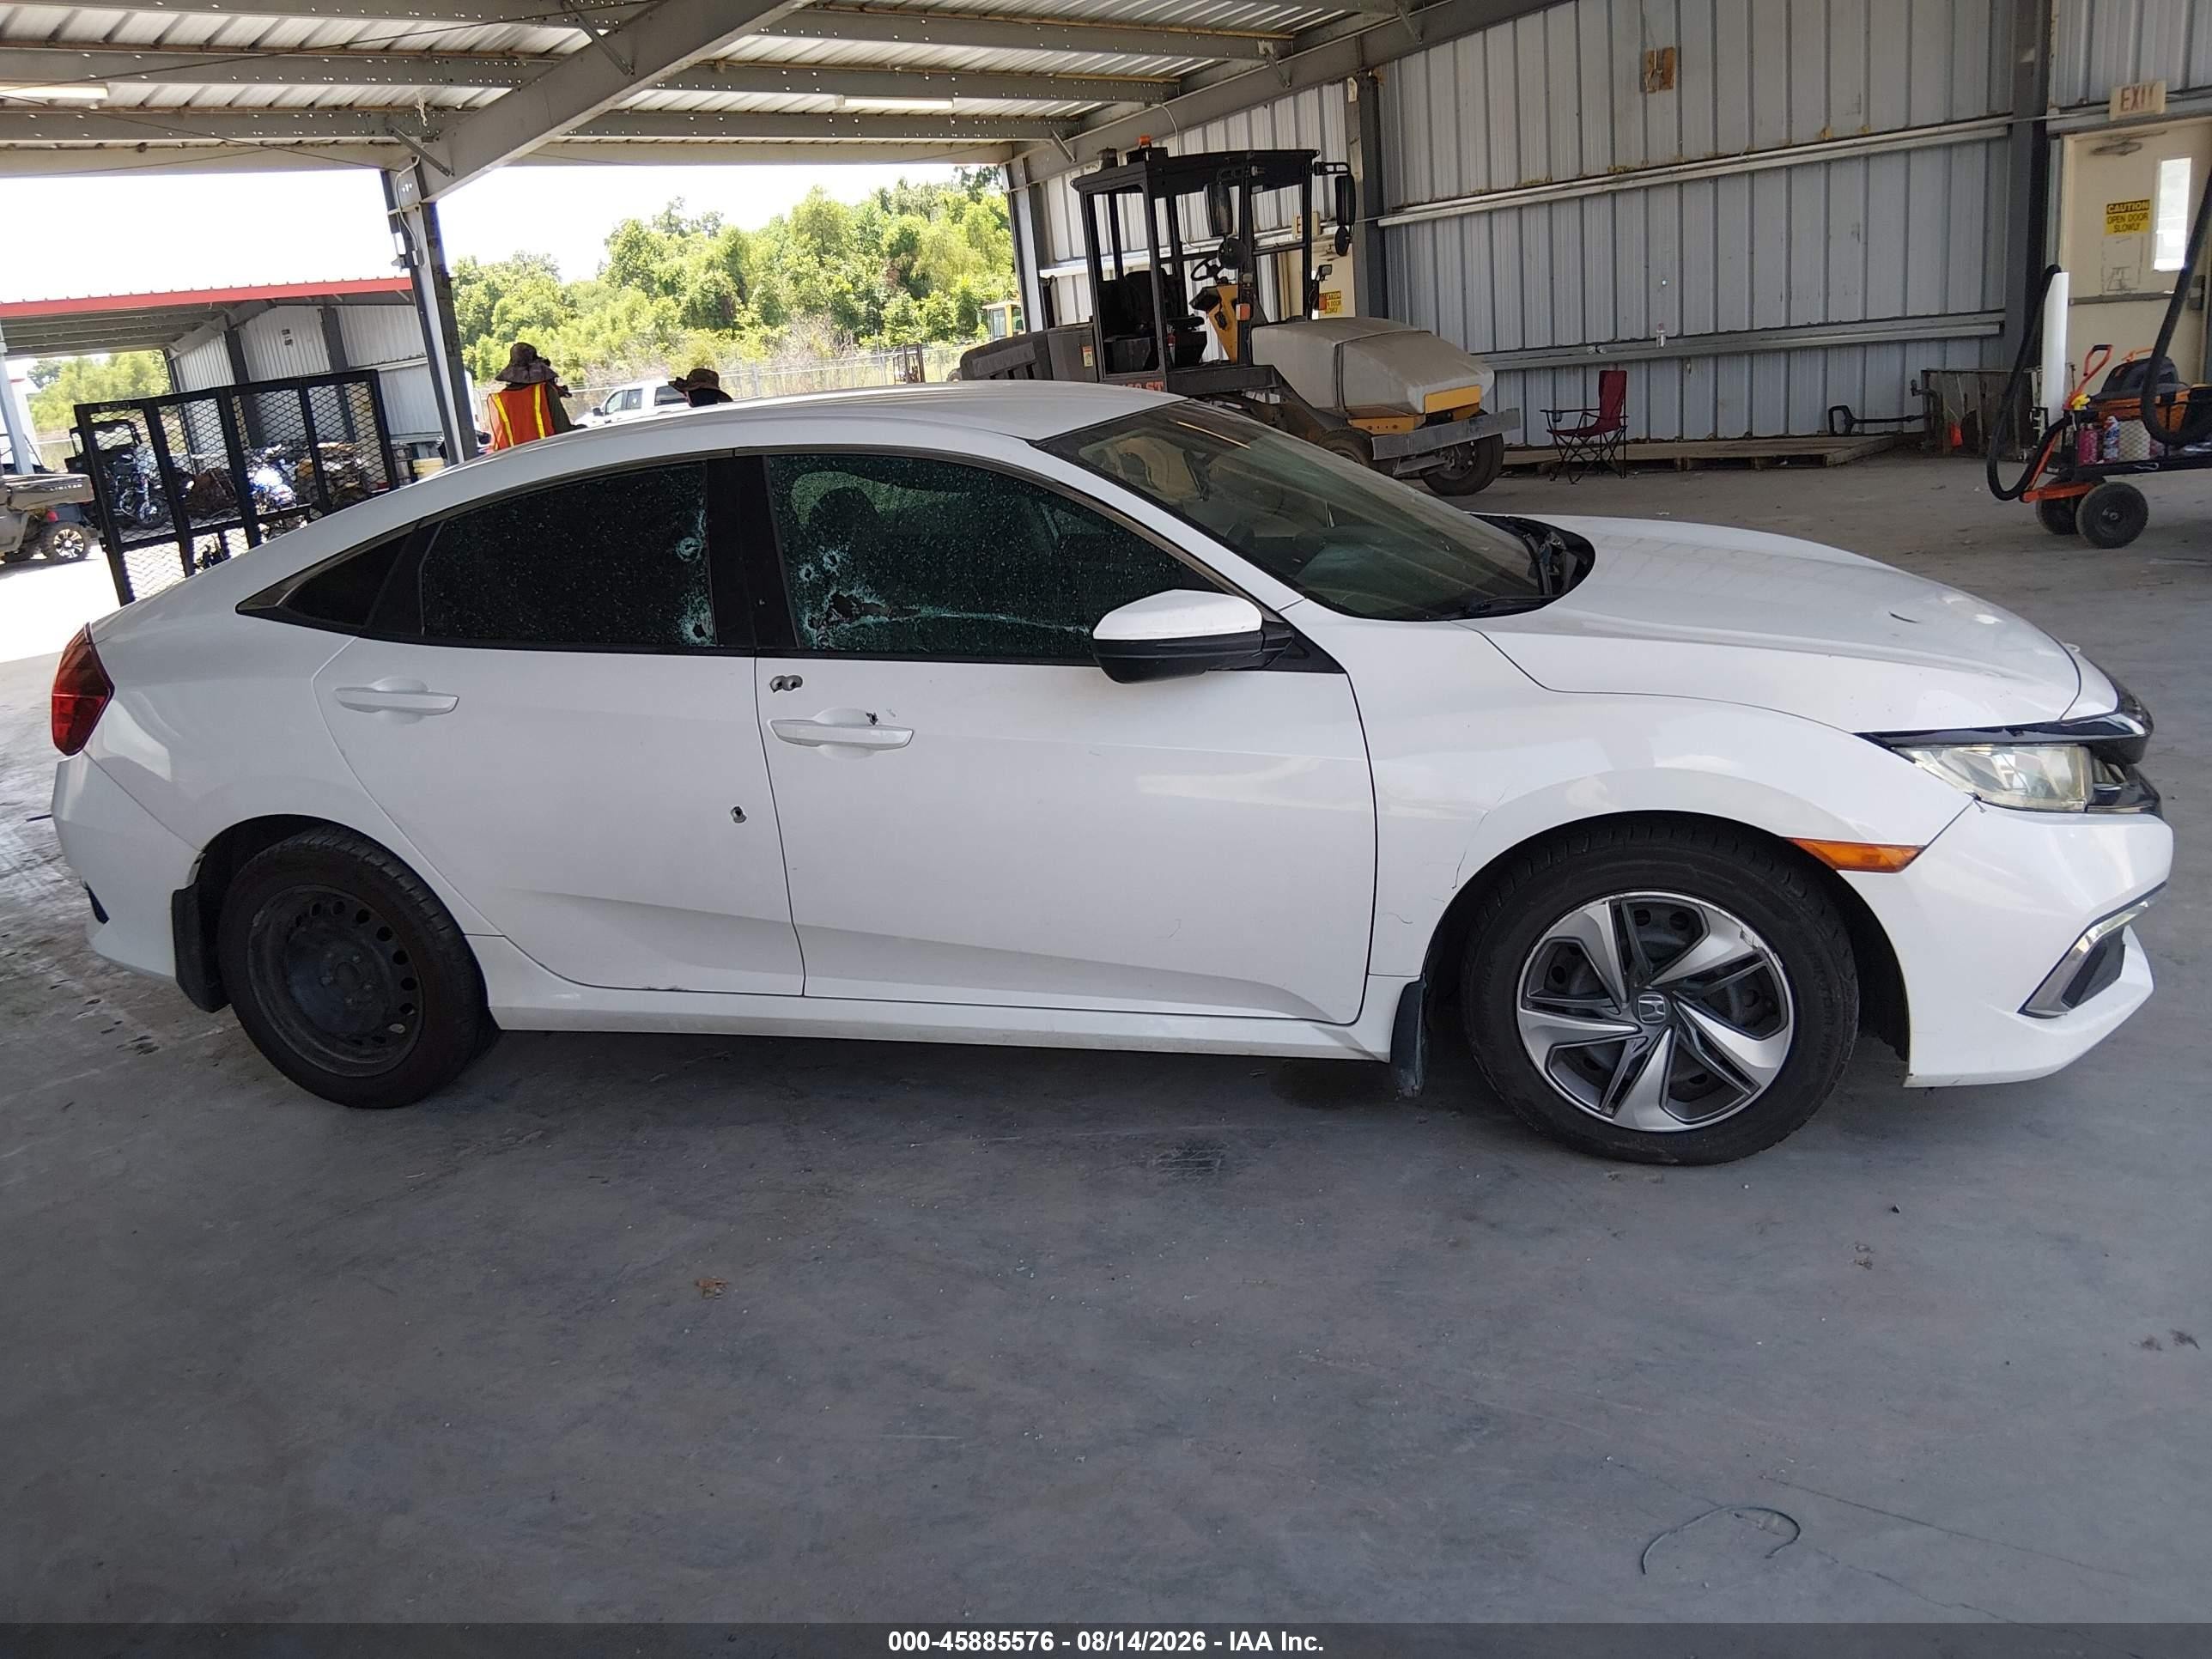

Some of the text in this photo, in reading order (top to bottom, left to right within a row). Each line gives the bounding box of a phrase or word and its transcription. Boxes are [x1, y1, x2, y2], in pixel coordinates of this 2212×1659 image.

[2121, 84, 2156, 111] EXIT
[2108, 201, 2148, 213] CAUTION
[2107, 213, 2148, 224] OPEN DOOR
